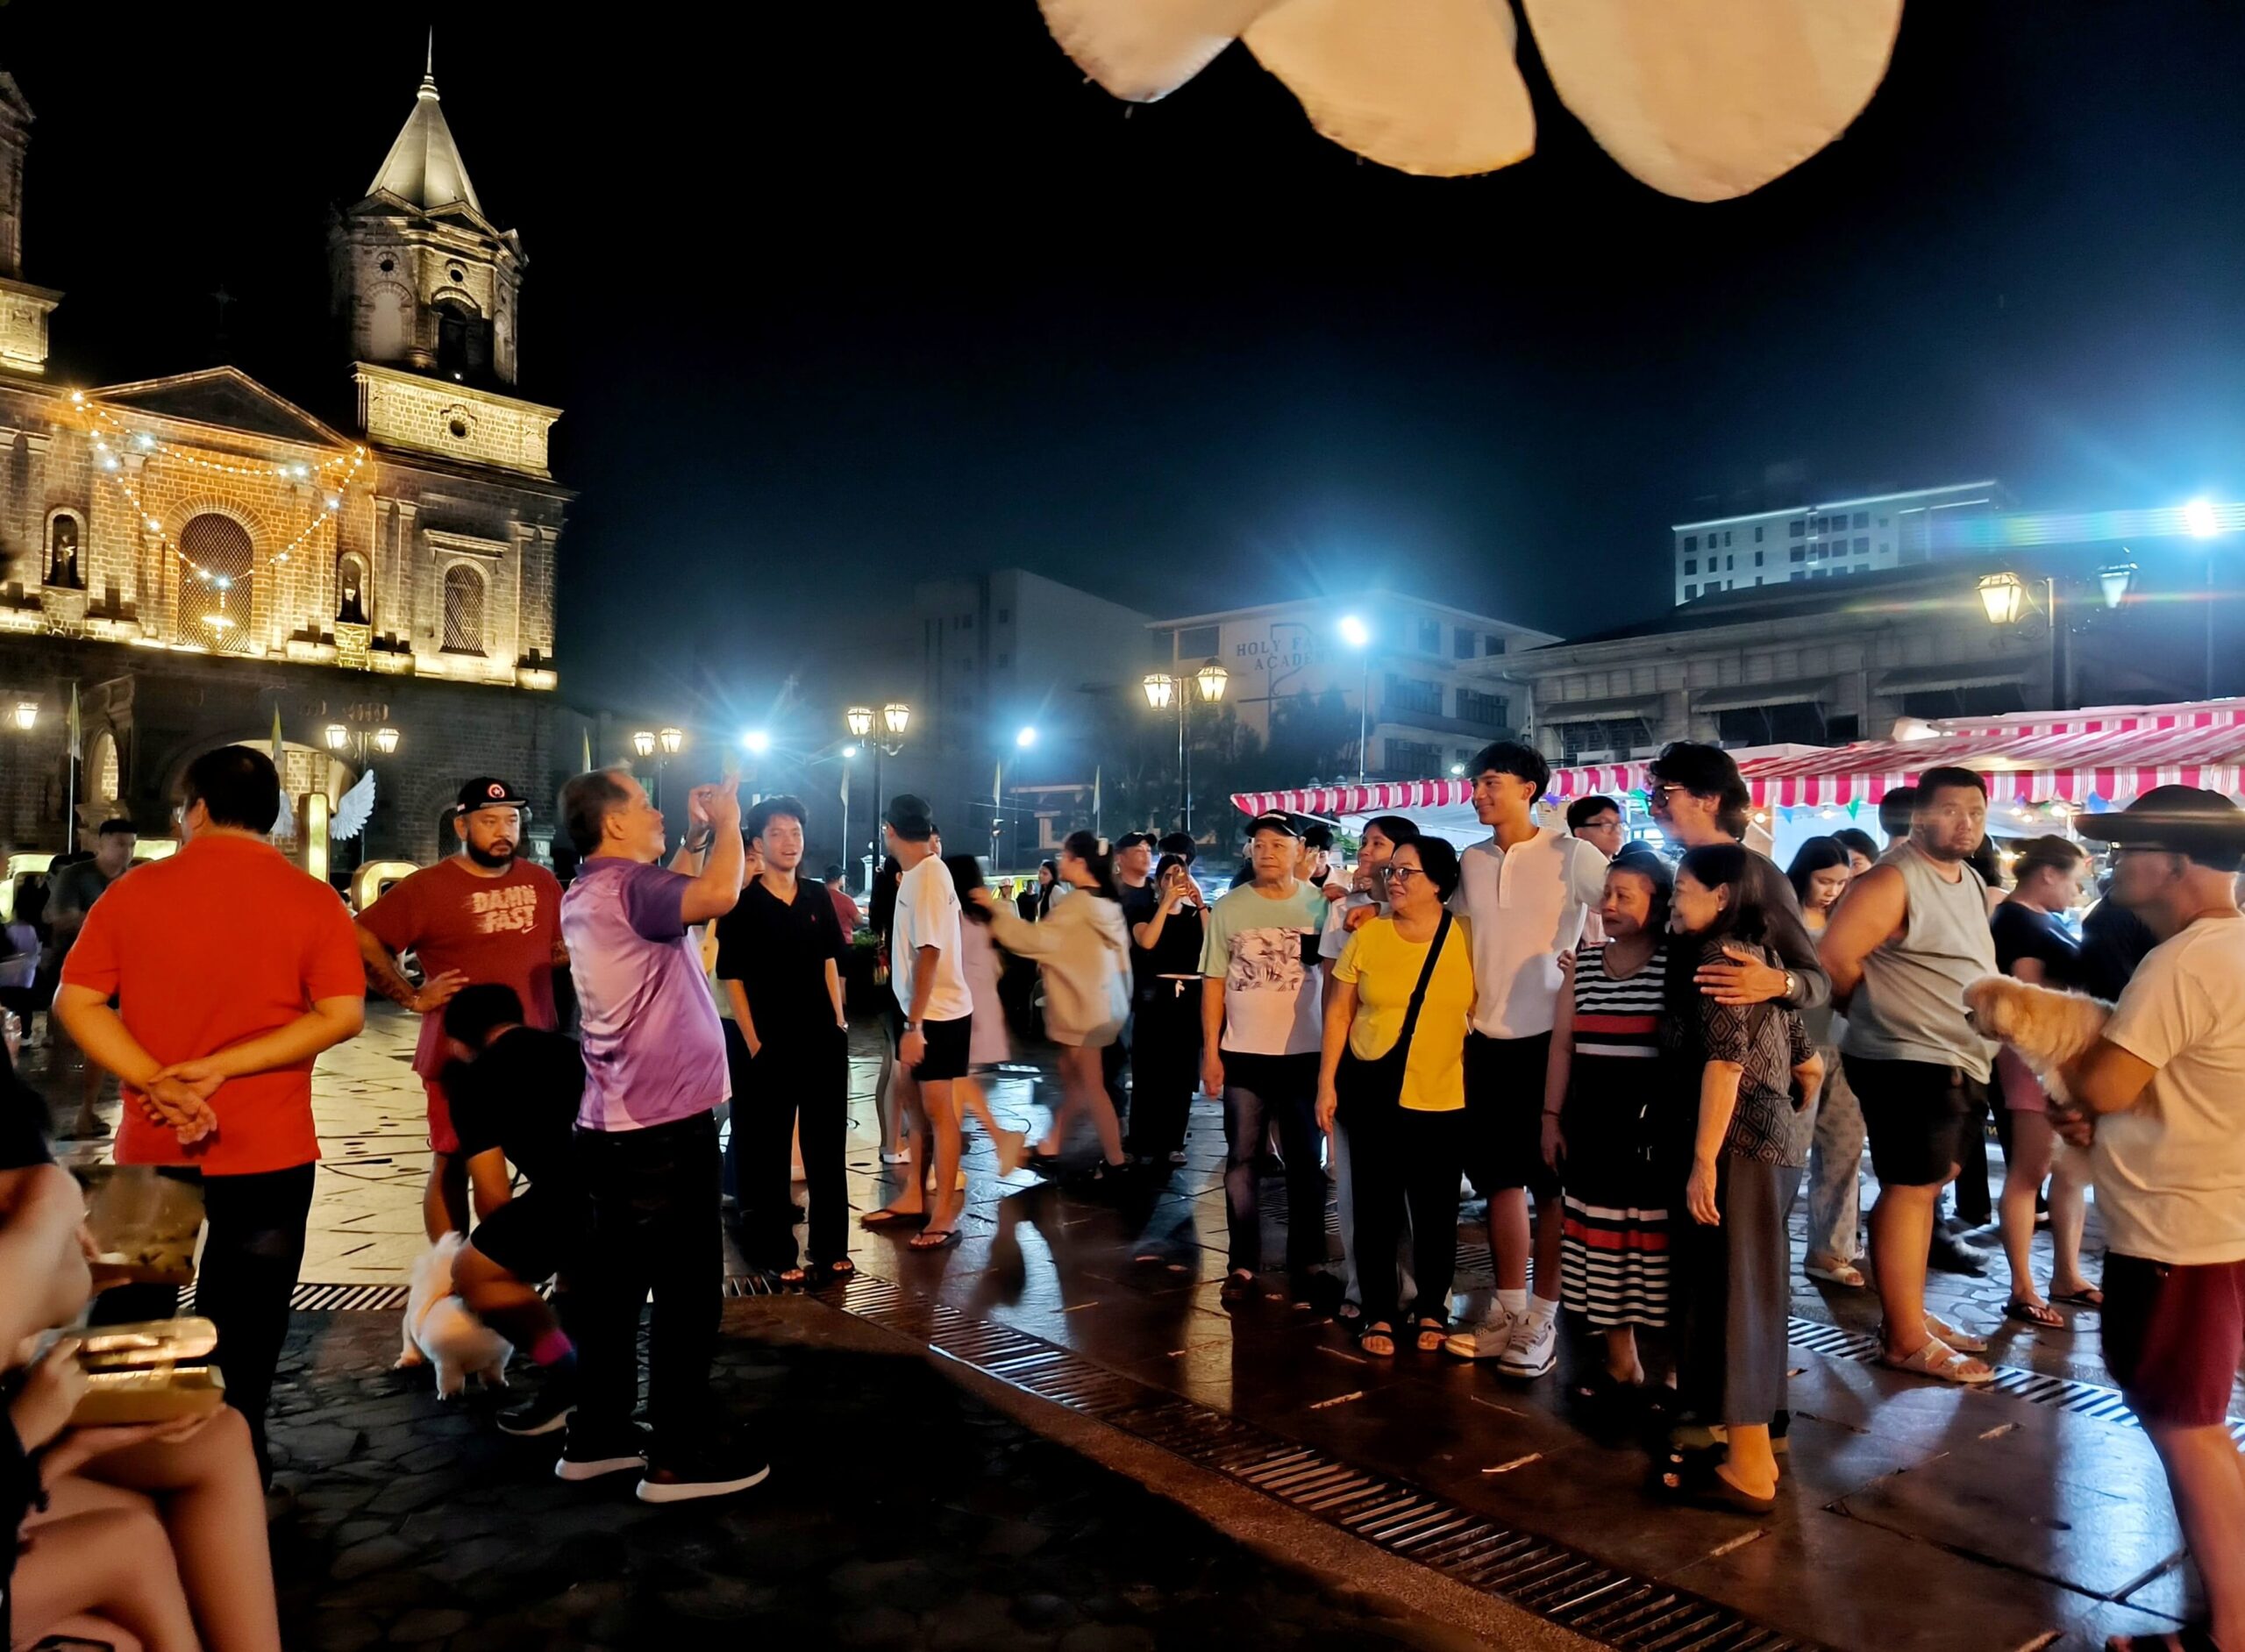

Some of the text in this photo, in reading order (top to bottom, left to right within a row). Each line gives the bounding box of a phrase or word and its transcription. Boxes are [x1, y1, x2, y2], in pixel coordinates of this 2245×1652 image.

[1237, 640, 1280, 657] HOLY
[1255, 652, 1334, 670] ACADEMY
[471, 885, 537, 914] DAMN
[483, 905, 535, 934] FAST
